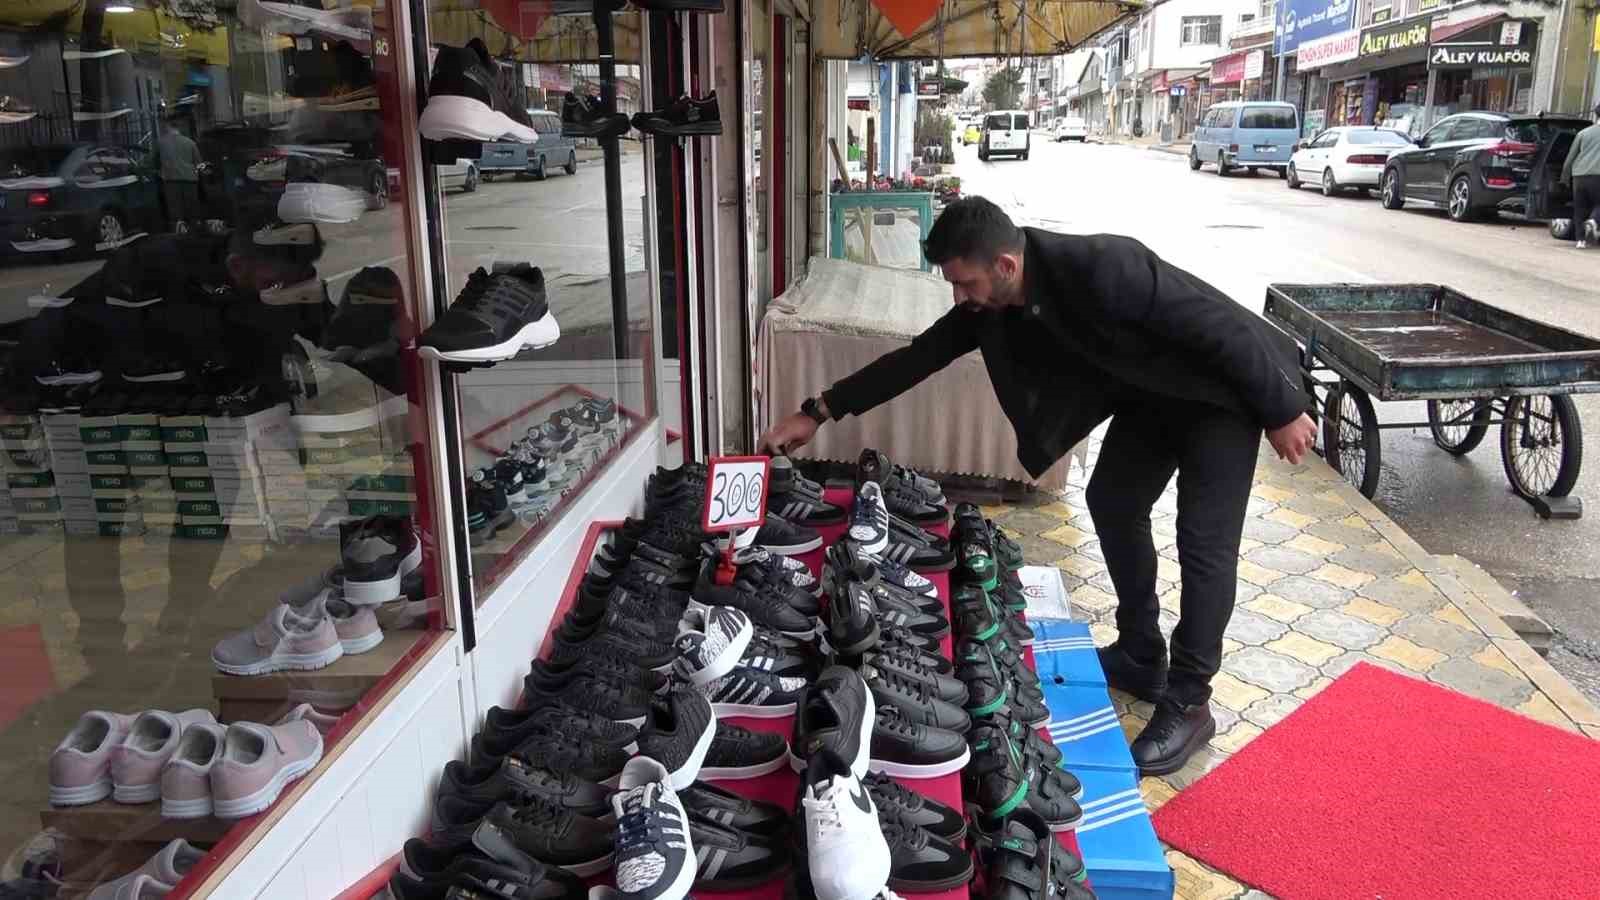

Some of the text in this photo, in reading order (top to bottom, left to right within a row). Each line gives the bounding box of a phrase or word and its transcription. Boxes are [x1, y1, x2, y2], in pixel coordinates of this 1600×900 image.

[1360, 25, 1426, 55] ALEV KUAFÖR
[1432, 47, 1530, 64] ALEV KUAFÖR
[711, 472, 765, 523] 300
